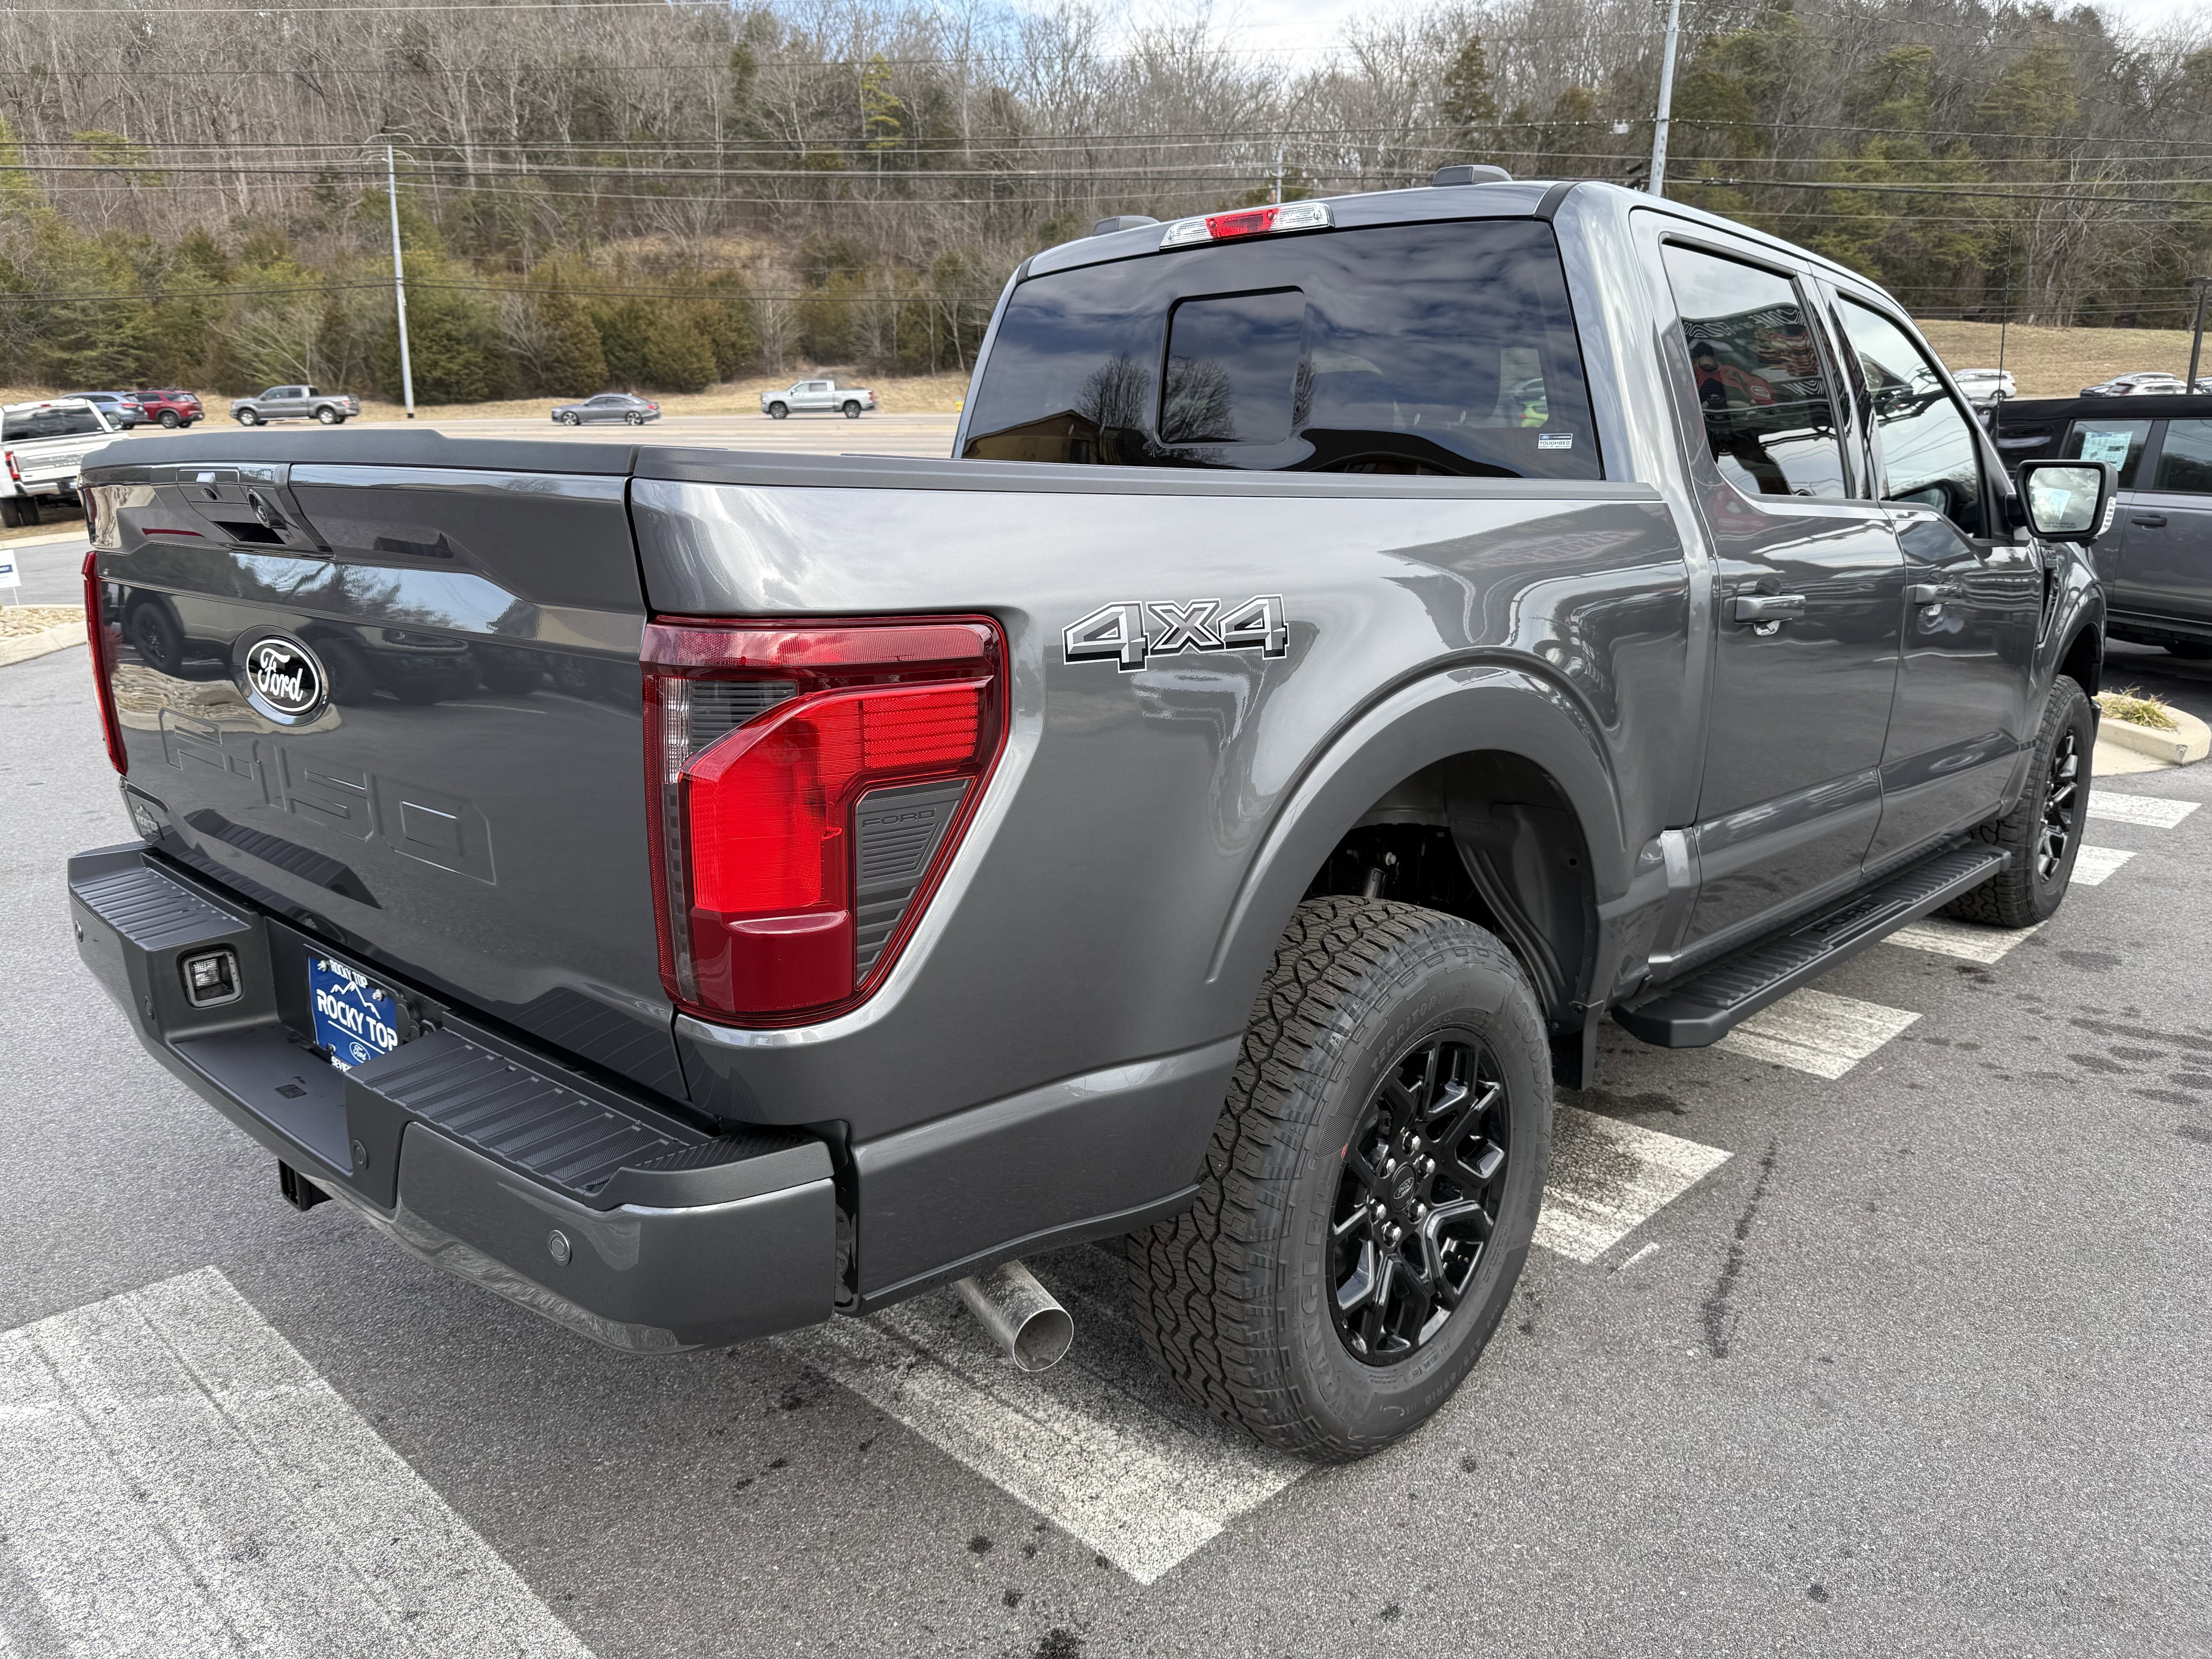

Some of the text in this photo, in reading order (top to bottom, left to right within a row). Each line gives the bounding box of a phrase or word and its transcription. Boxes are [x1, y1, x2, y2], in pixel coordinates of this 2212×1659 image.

[258, 648, 303, 702] Ford
[862, 809, 935, 828] FORD
[330, 960, 368, 988] ROCKY TOP
[317, 989, 398, 1051] ROCKY TOP
[1370, 990, 1446, 1073] TERRITORY
[354, 1044, 367, 1061] Ford
[1513, 1001, 1551, 1222] GOODYEAR
